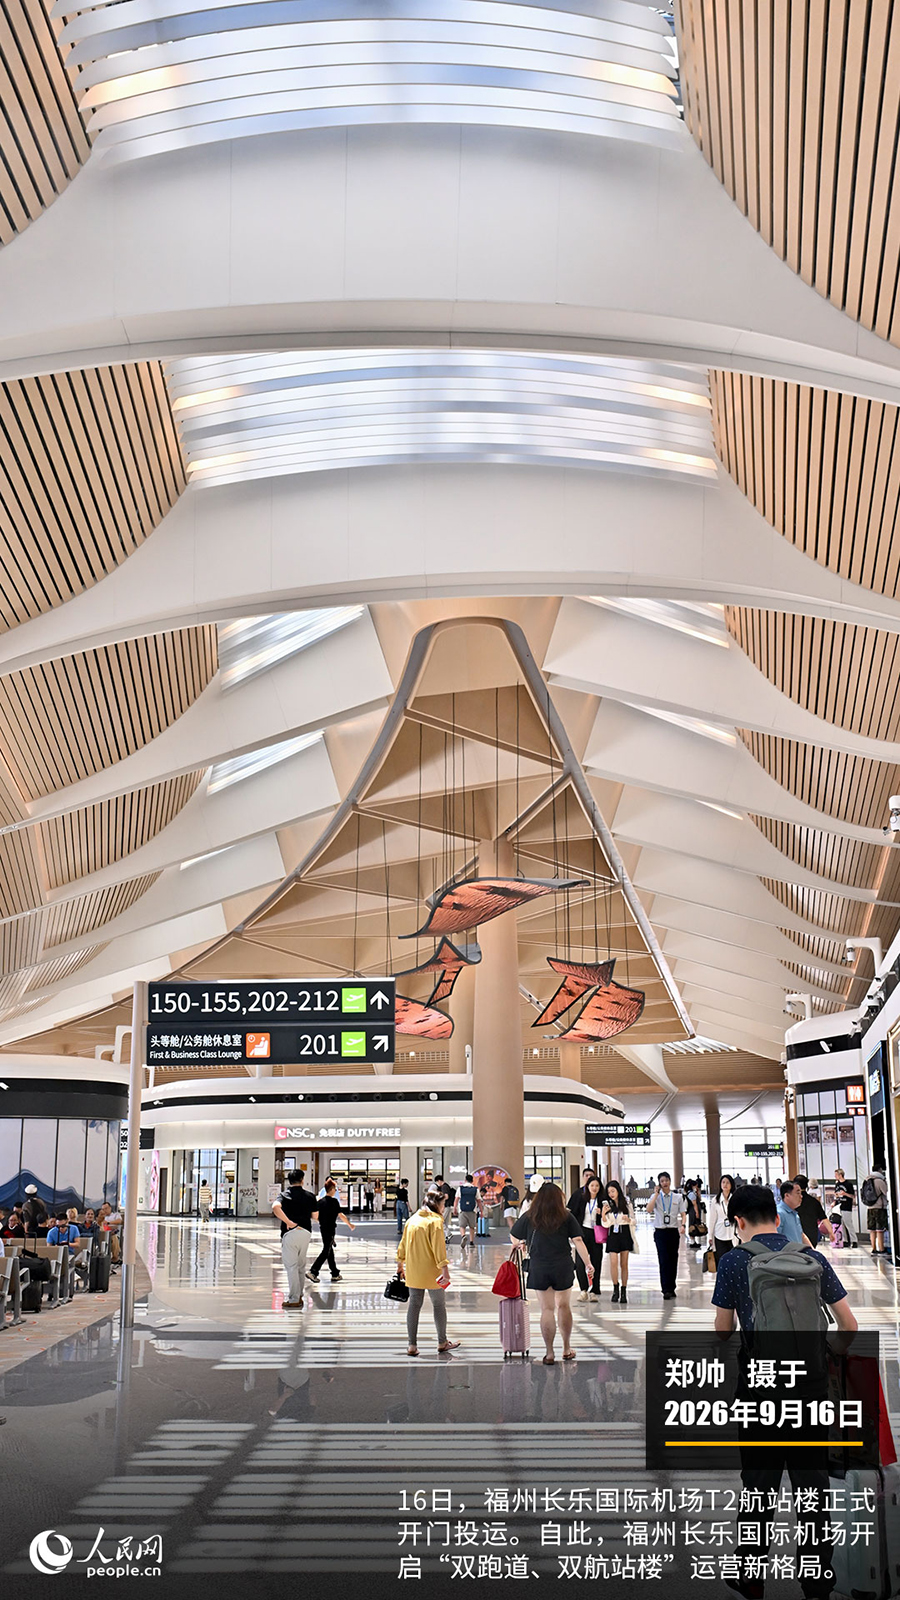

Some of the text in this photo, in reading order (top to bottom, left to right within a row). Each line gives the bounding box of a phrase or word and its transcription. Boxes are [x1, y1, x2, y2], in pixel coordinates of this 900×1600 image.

[151, 990, 340, 1016] 150-155,202-212
[150, 1033, 243, 1049] 头等舱/公务舱休息室
[299, 1034, 339, 1055] 201
[149, 1050, 243, 1060] First & Business Class Lounge
[277, 1127, 310, 1138] CNSC
[347, 1127, 401, 1137] DUTY FREE
